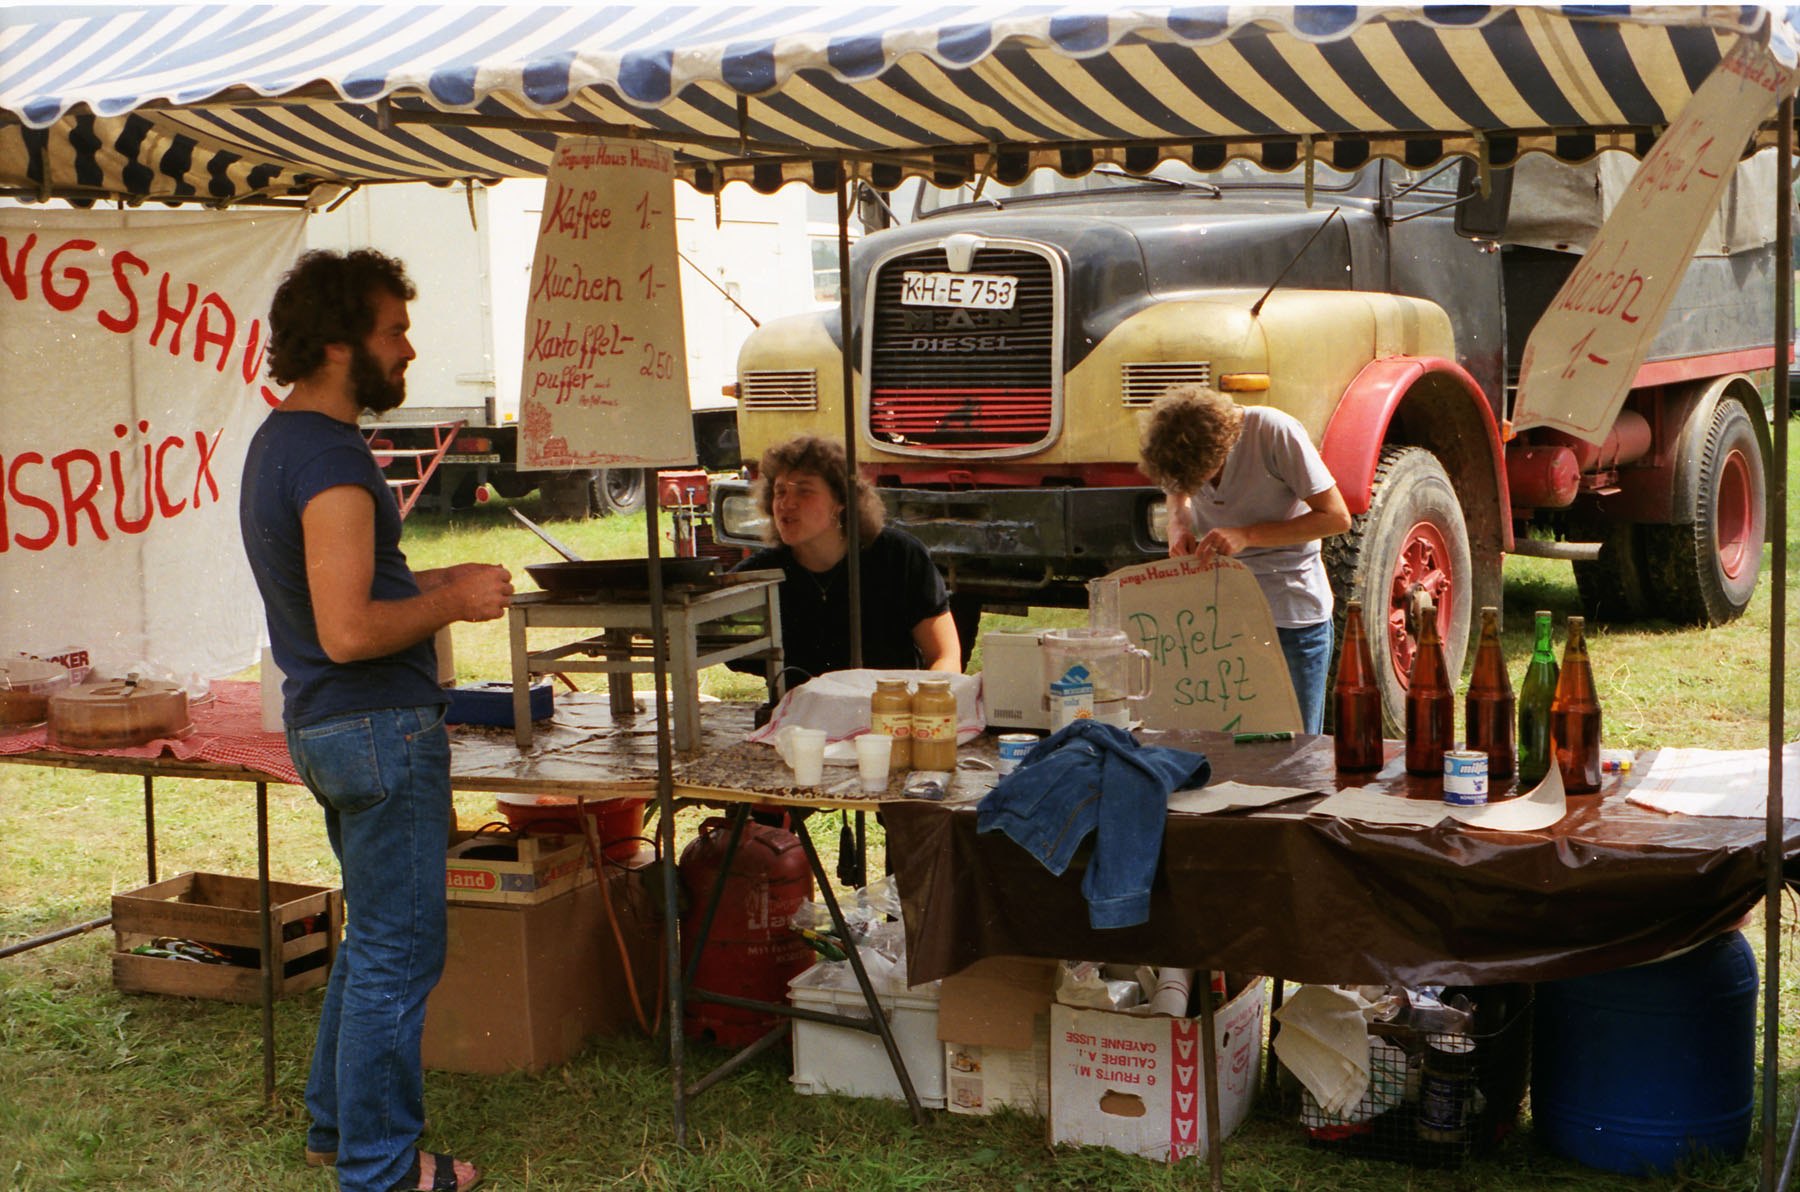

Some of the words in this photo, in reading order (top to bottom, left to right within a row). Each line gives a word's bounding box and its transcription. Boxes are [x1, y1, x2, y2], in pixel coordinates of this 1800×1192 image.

[543, 185, 611, 239] Kaffee
[533, 254, 623, 302] Kuchen
[970, 280, 1012, 304] 753
[527, 319, 634, 369] Kartoffel-
[911, 336, 1014, 352] DIESEL
[531, 365, 594, 404] puffer
[1146, 566, 1179, 580] Haus
[1129, 606, 1243, 669] Apfel-
[1174, 657, 1256, 711] saft
[447, 872, 486, 887] land
[1066, 1031, 1097, 1046] LISSE
[1101, 1037, 1157, 1053] CAYENNE
[1102, 1053, 1156, 1069] CALIBRE
[1096, 1068, 1140, 1084] FRUITS
[1147, 1075, 1156, 1085] 6
